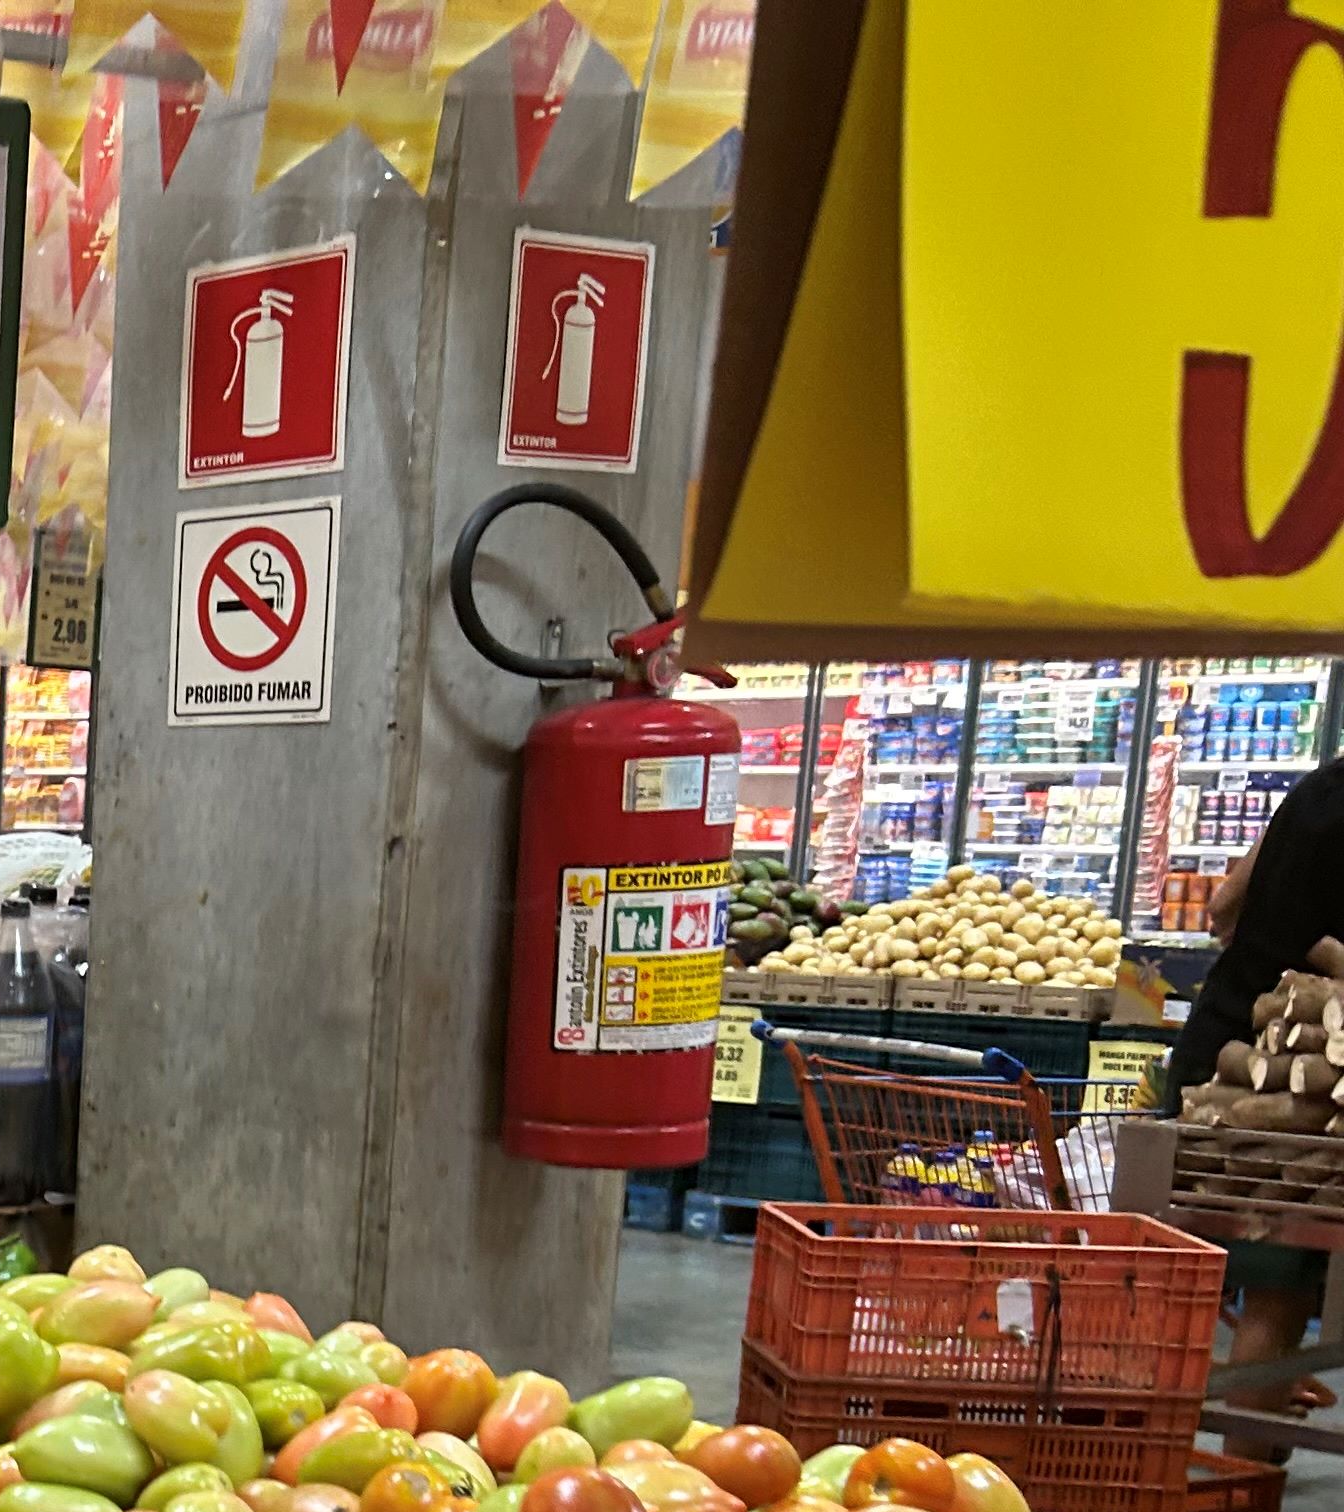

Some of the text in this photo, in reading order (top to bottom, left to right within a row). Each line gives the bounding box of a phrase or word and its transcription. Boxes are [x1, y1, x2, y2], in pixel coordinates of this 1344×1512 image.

[512, 432, 558, 450] EXTINTOR
[192, 450, 245, 470] EXTINTOR
[185, 679, 312, 706] PROIBIDO FUMAR
[614, 869, 704, 889] EXTINTOR
